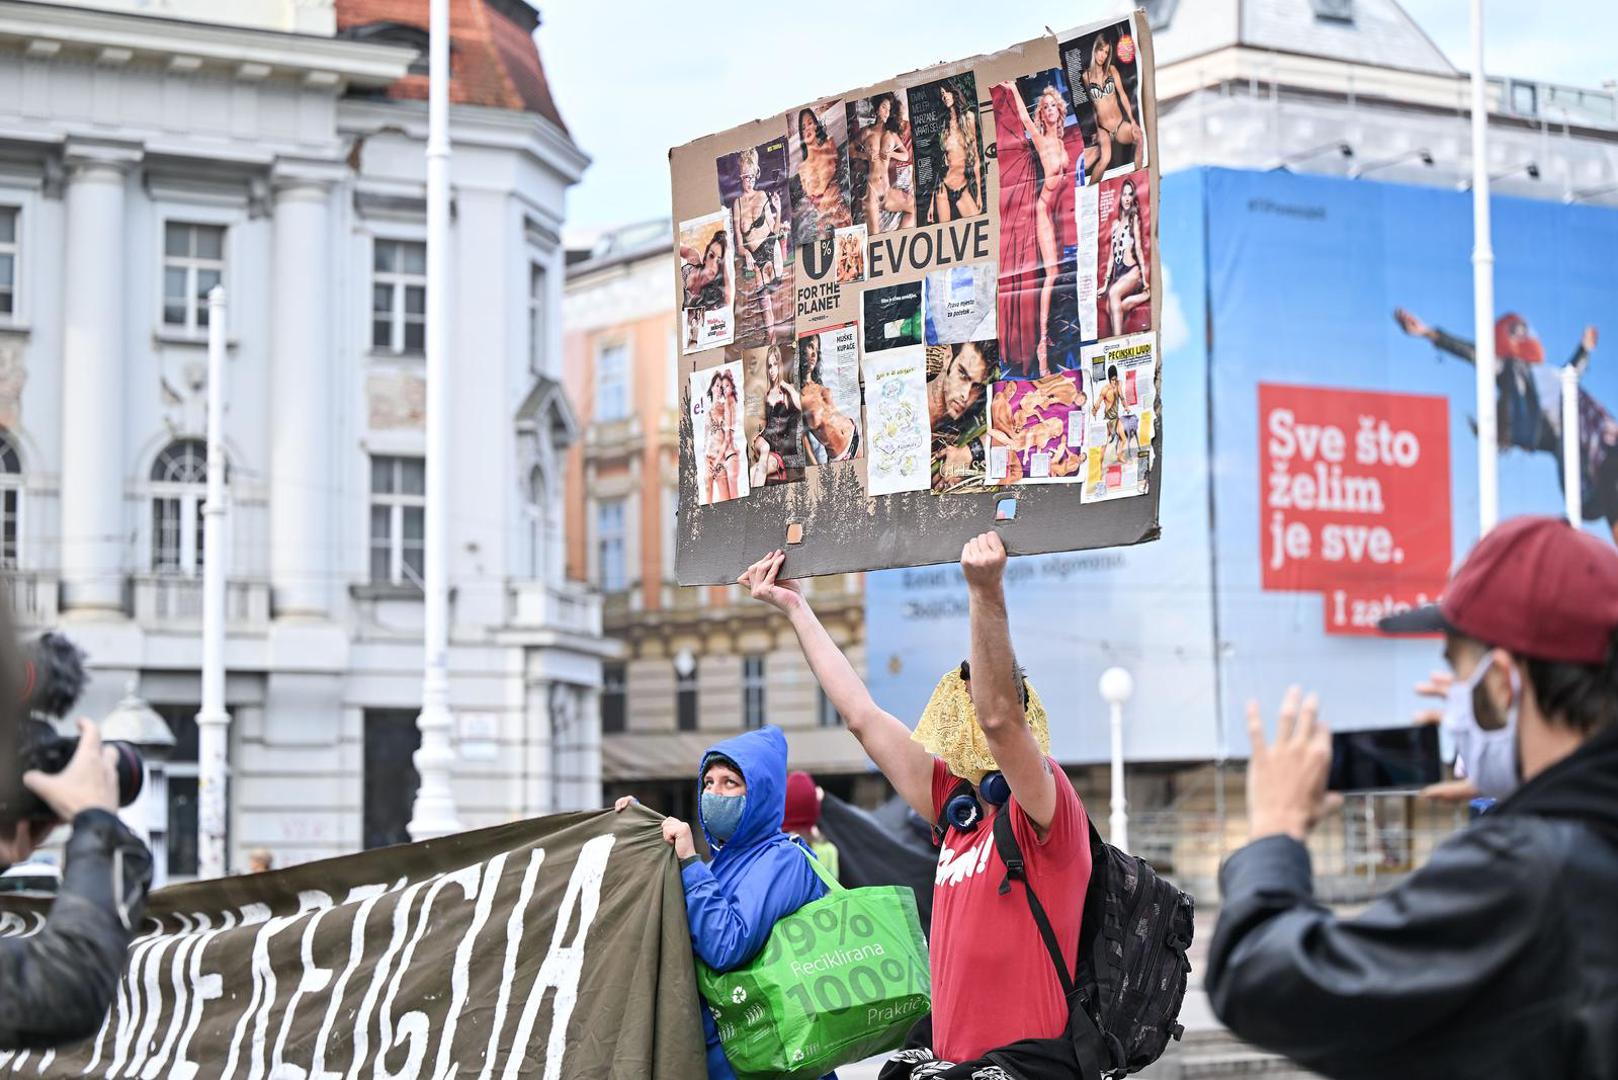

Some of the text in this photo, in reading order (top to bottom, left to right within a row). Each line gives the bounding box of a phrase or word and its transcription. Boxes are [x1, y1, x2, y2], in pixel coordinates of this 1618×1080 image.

[869, 219, 990, 278] EVOLVE
[797, 281, 841, 302] FOR THE
[797, 294, 841, 317] PLANET
[693, 397, 704, 415] e!
[1268, 408, 1420, 468] Sve što
[1268, 460, 1384, 514] želim
[1270, 510, 1405, 570] je sve.
[790, 943, 885, 977] Reciklirana
